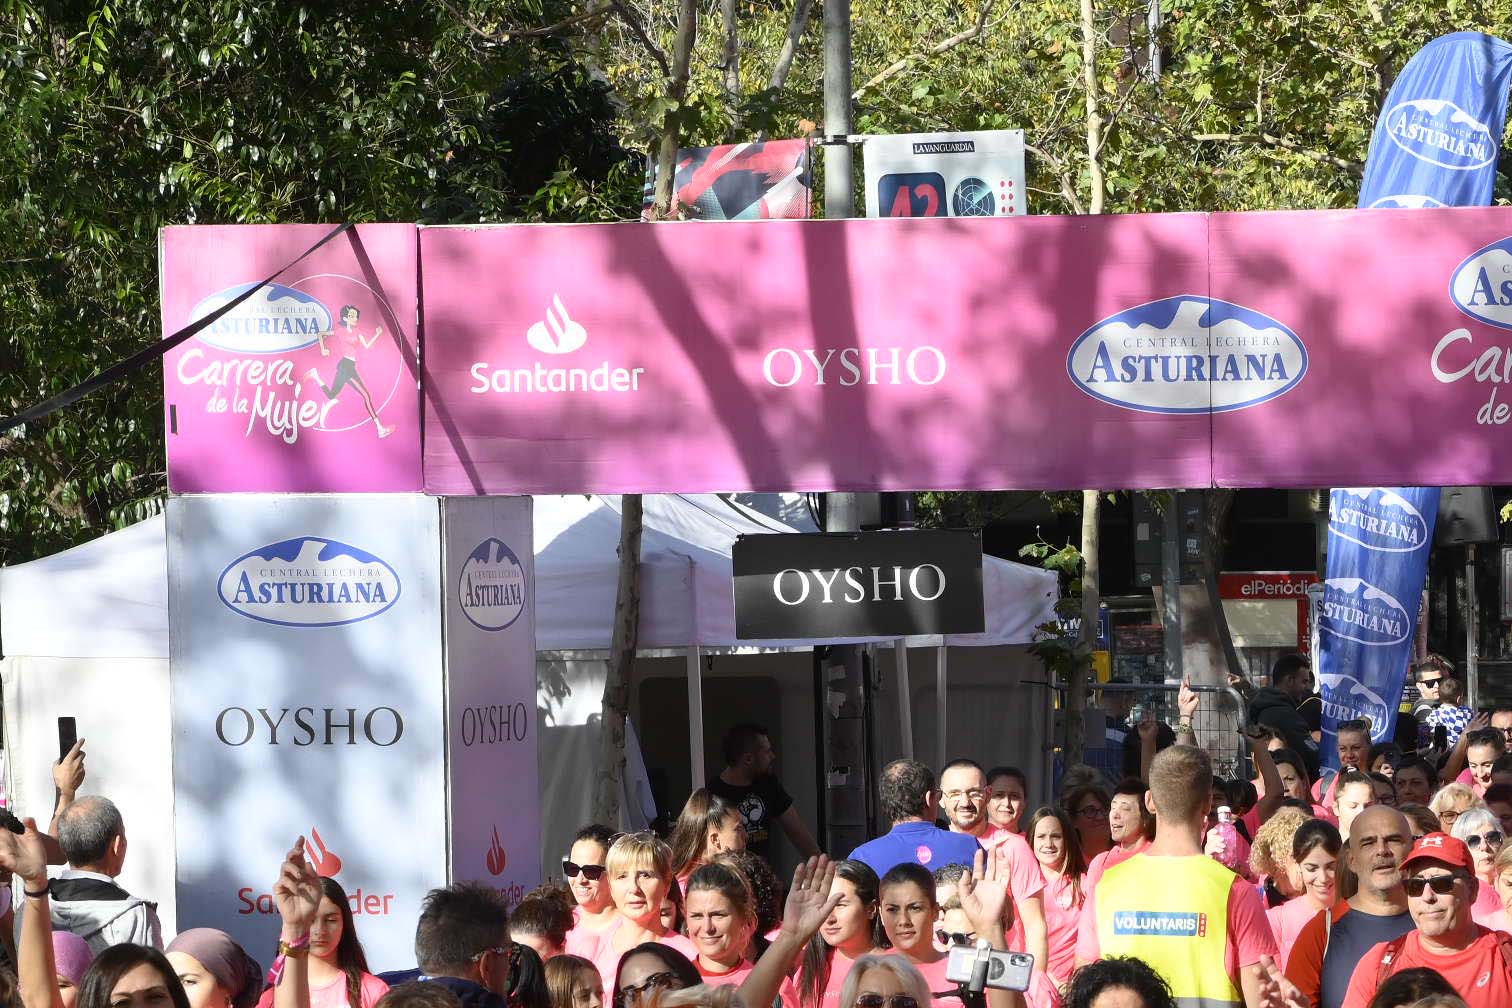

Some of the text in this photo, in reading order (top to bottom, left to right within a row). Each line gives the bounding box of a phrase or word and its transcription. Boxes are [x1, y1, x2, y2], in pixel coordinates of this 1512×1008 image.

[924, 142, 974, 153] VANGUARDIA
[1122, 335, 1281, 349] CENTRAL LECHERA
[176, 348, 294, 386] Carrera
[470, 361, 645, 394] Santander
[763, 345, 947, 387] OYSHO
[1086, 340, 1289, 384] ASTURIANA
[207, 382, 339, 445] de la Mujer
[1476, 386, 1511, 426] de
[1328, 497, 1419, 545] ASTURIANA
[232, 570, 388, 605] ASTURIANA
[260, 567, 382, 578] CENTRAL LECHERA
[464, 572, 522, 608] ASTURIANA
[772, 562, 947, 606] OYSHO
[1241, 579, 1310, 596] elPeriódi
[1322, 601, 1402, 638] STURIANA
[215, 706, 404, 748] OYSHO
[462, 702, 528, 747] OYSHO
[237, 886, 395, 916] Sader
[490, 884, 526, 907] nder
[1115, 916, 1196, 931] VOLUNTARIS
